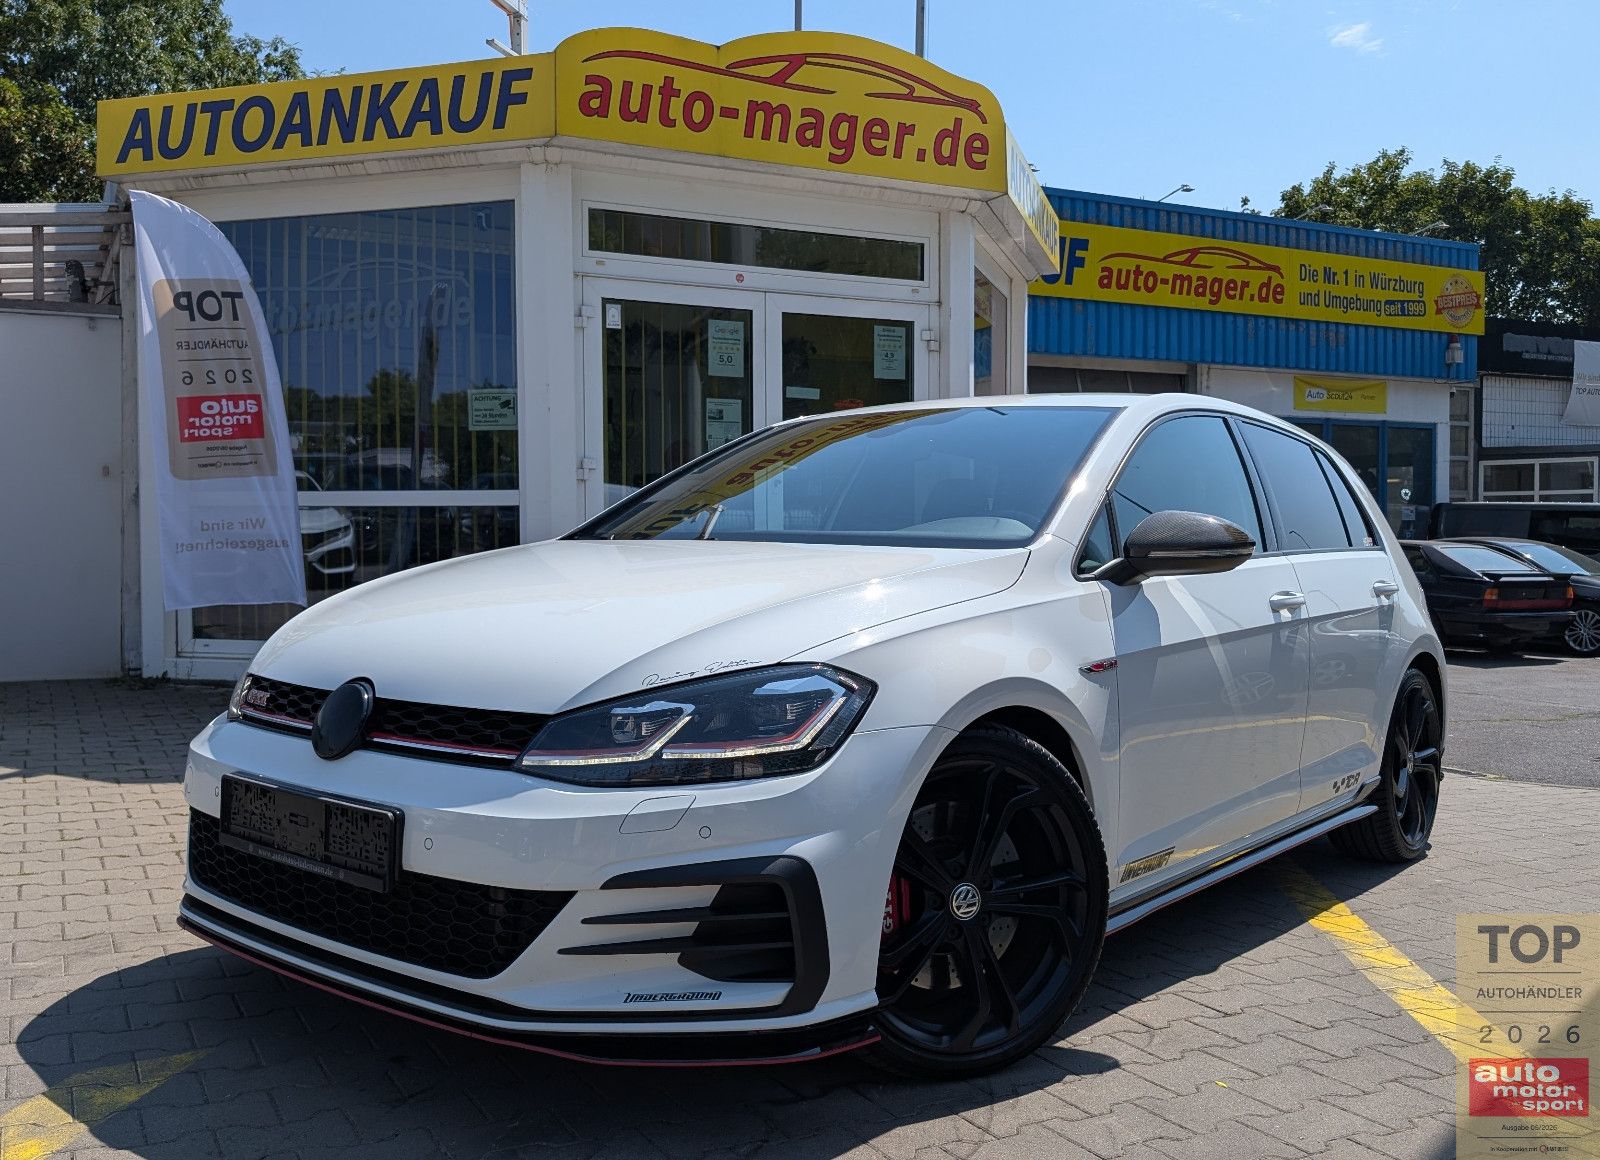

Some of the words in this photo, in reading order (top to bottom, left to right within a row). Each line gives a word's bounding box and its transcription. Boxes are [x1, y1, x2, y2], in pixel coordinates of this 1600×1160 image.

[116, 68, 533, 164] AUTOANKAUF
[578, 74, 990, 171] auto-mager.de
[1036, 236, 1090, 285] UF
[1299, 263, 1319, 283] Die
[1323, 266, 1340, 286] Nr.
[1343, 269, 1349, 286] 1
[1354, 270, 1365, 289] in
[1369, 271, 1425, 298] Würzburg
[1097, 264, 1285, 306] auto-mager.de
[1299, 289, 1320, 307] und
[1323, 290, 1382, 317] Umgebung
[1385, 302, 1401, 315] seit
[1404, 302, 1425, 316] 1999
